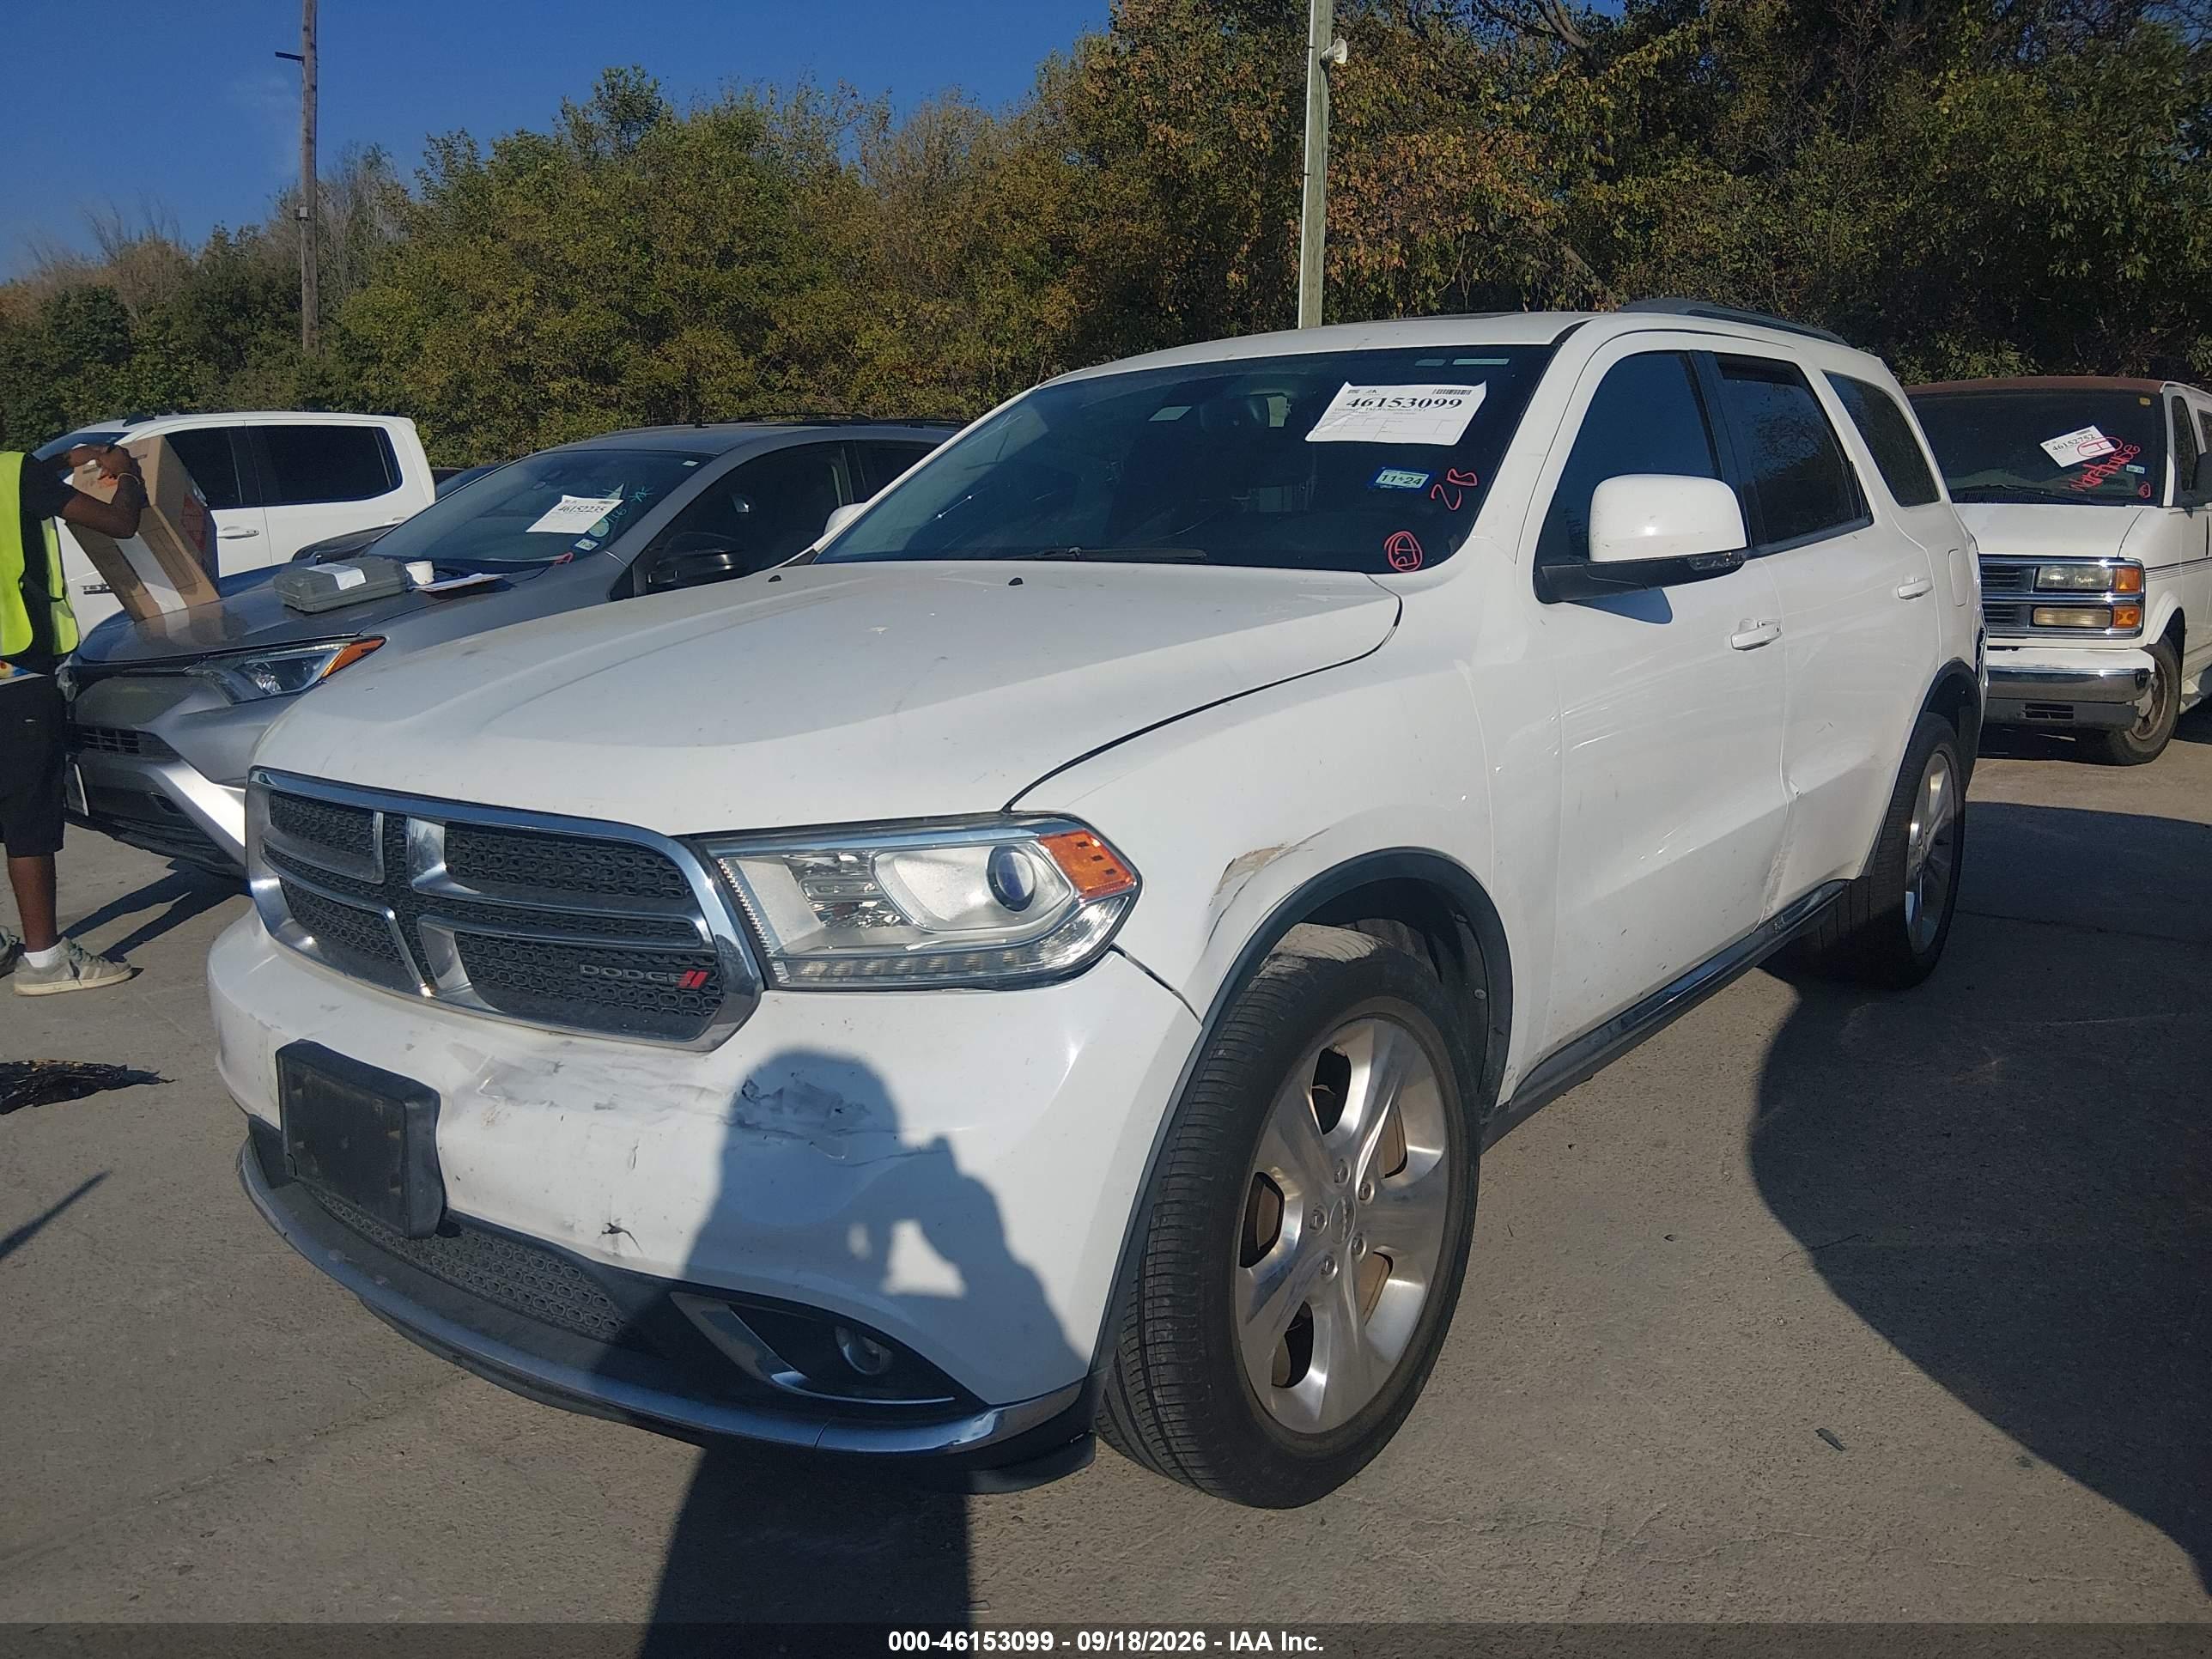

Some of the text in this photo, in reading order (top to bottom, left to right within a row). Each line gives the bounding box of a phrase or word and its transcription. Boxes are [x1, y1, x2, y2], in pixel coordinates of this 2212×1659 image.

[1346, 397, 1463, 410] 46153099
[2052, 434, 2095, 451] 46152752
[580, 963, 686, 983] DODGE
